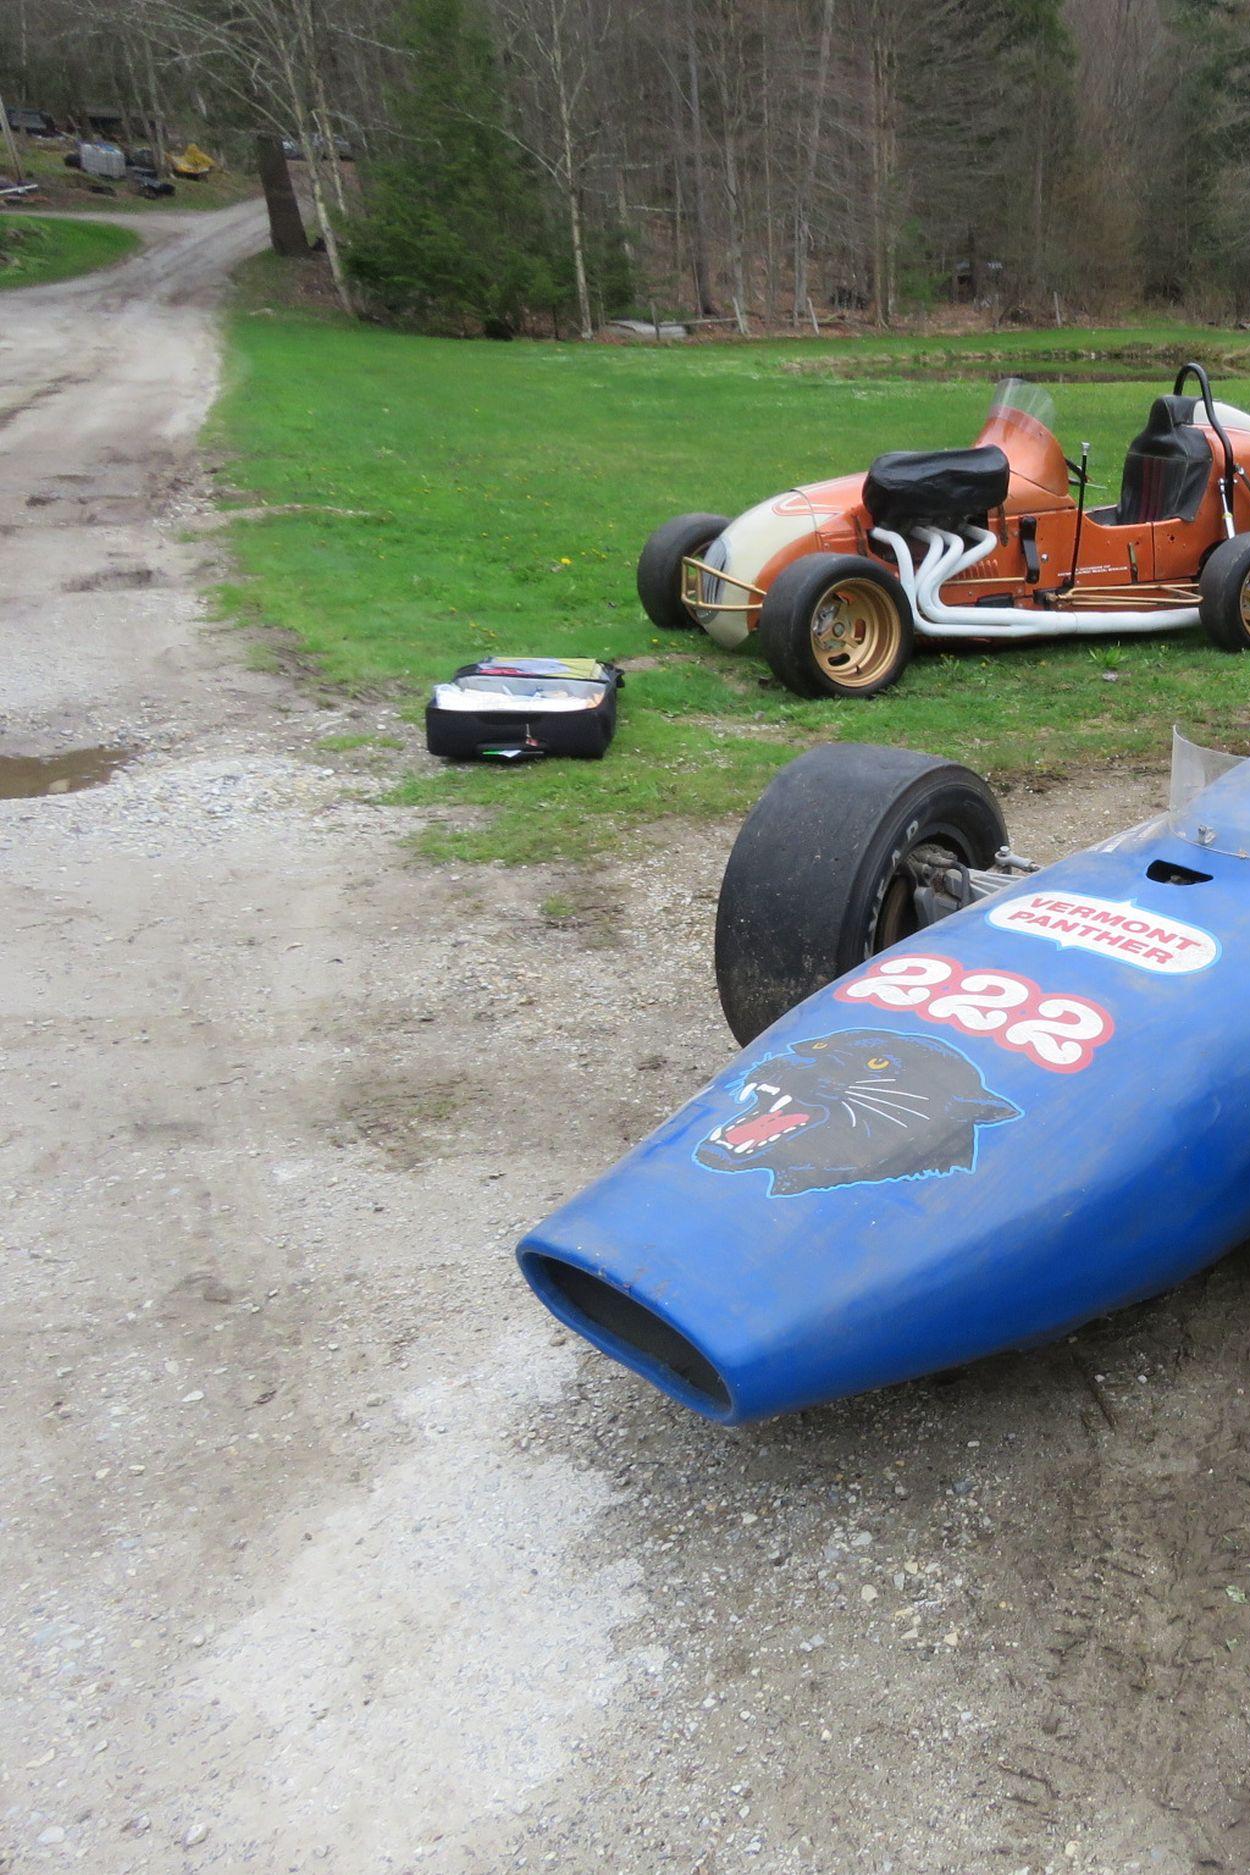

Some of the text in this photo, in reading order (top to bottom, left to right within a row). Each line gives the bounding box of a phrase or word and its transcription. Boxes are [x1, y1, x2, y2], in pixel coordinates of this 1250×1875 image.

[1007, 910, 1174, 964] PANTHER
[1029, 897, 1203, 951] VERMONT
[845, 956, 1105, 1066] 222
